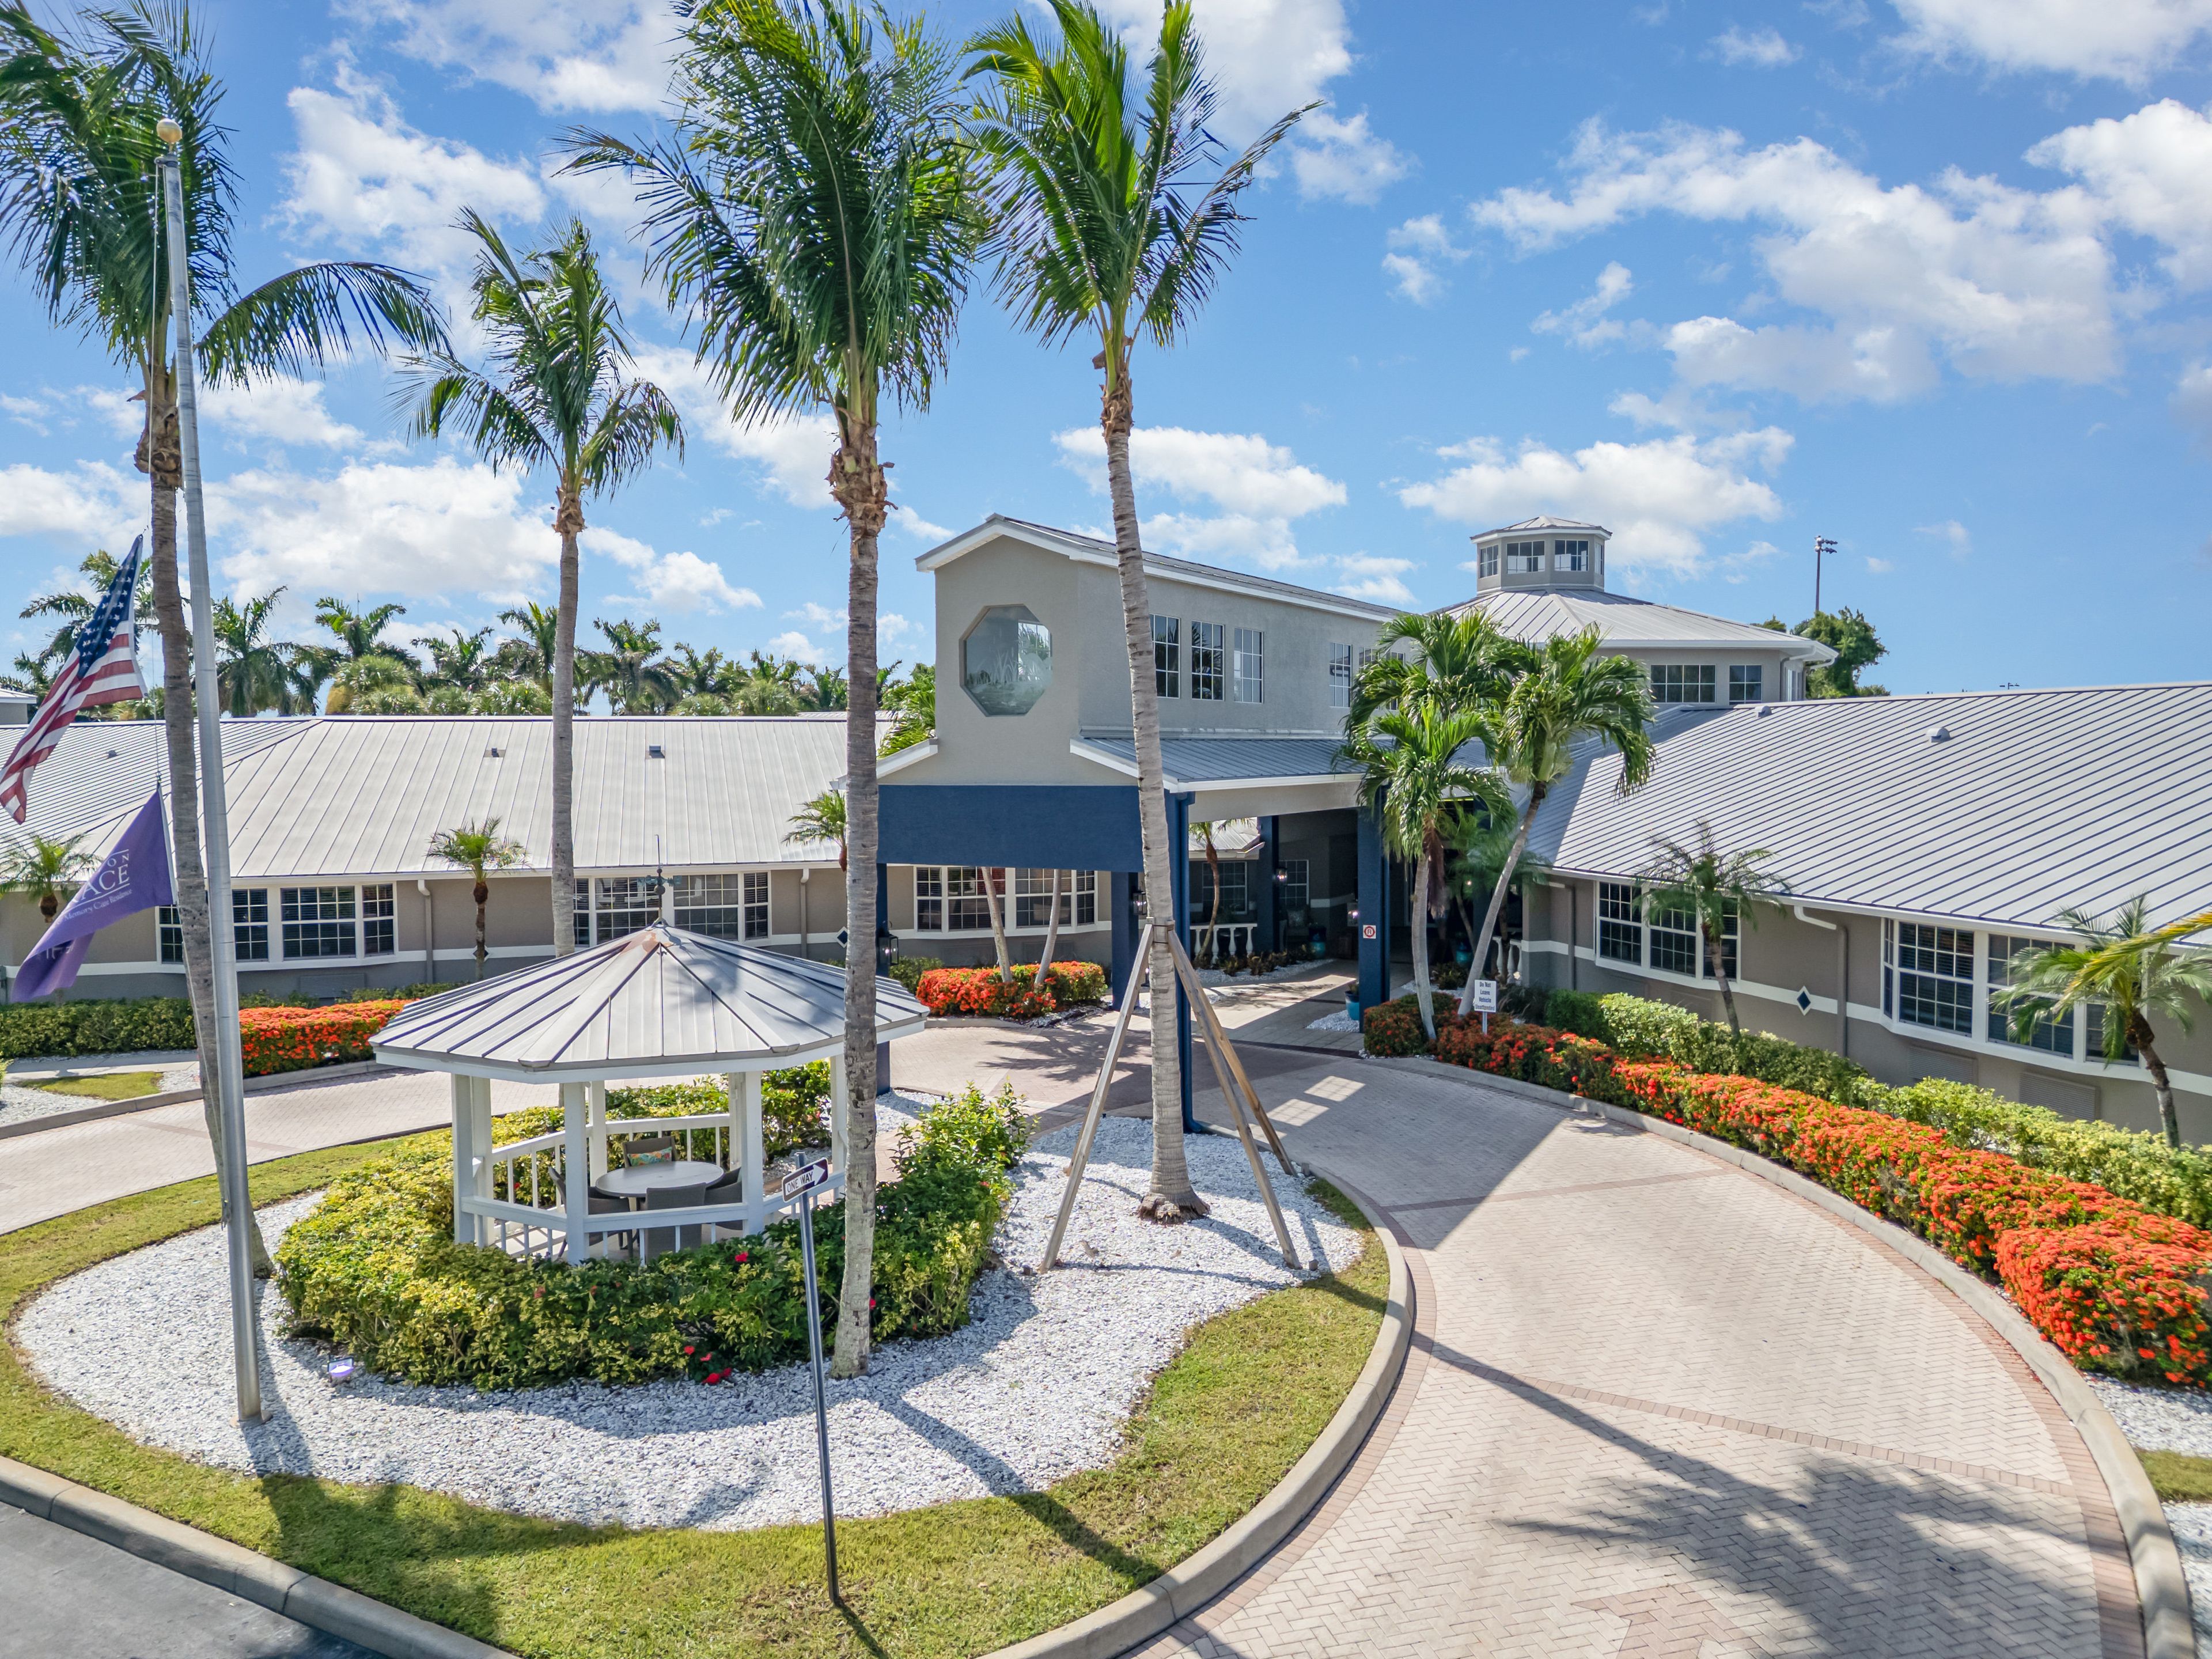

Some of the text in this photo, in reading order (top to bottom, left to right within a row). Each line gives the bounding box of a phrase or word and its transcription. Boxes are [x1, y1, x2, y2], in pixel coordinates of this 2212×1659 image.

[73, 863, 130, 903] ACE
[787, 1171, 813, 1193] ONE WAY
